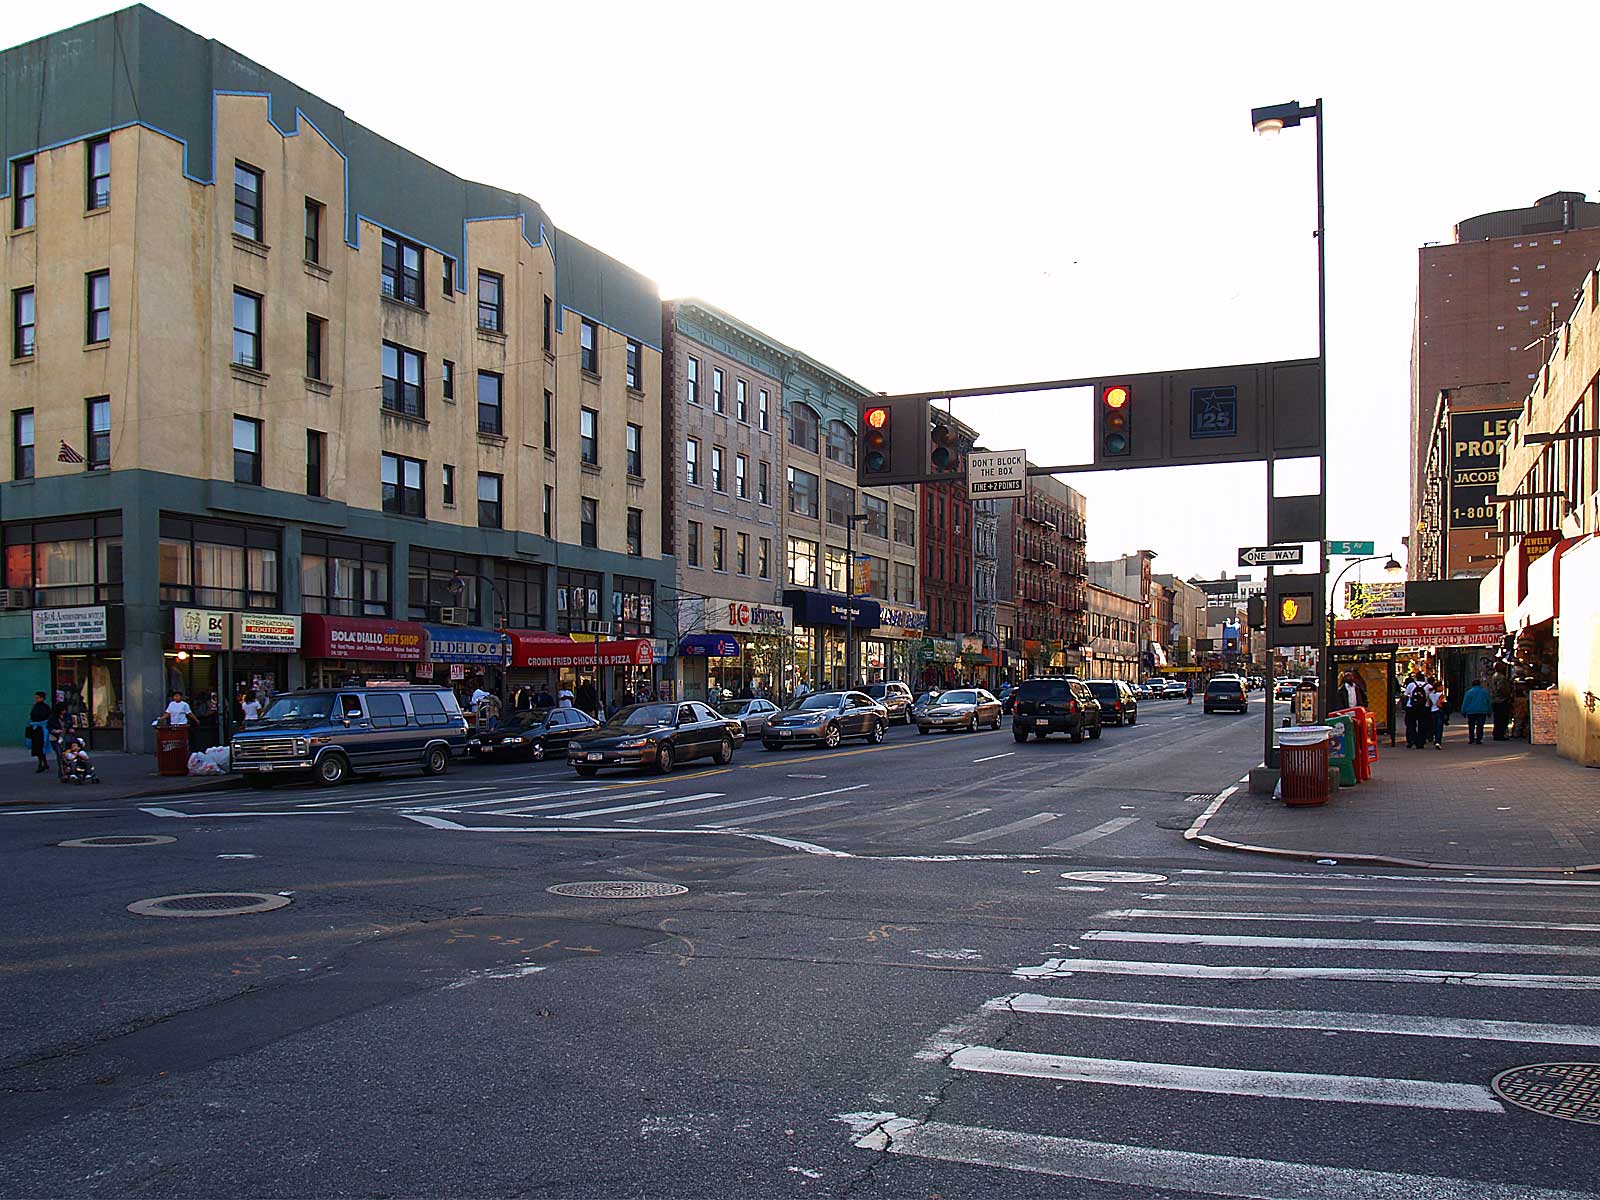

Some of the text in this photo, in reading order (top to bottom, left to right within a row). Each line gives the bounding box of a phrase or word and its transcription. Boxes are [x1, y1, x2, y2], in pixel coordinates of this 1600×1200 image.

[997, 456, 1021, 466] BLOCK
[981, 467, 1013, 477] THE BOX
[998, 480, 1020, 490] POINTS
[1524, 537, 1552, 546] JEWELRY
[1342, 542, 1351, 554] 5
[1247, 551, 1295, 561] ONE WAY
[245, 619, 294, 627] INTERNATIONAL
[251, 626, 289, 634] BOUTIQUE
[1352, 629, 1378, 637] WEST
[1382, 628, 1418, 636] DINNER
[1422, 626, 1466, 634] THEATRE
[357, 632, 382, 644] DIALLO
[383, 634, 399, 645] GIFT
[400, 634, 419, 645] SHOP
[1411, 636, 1435, 646] TRADE
[1437, 635, 1458, 645] GOLD
[447, 642, 474, 654] DELI
[528, 657, 552, 666] CROWN
[552, 657, 571, 666] FRIED
[572, 656, 602, 665] CHICKEN
[610, 655, 631, 664] PIZZA
[416, 663, 432, 673] ATM
[451, 665, 464, 674] ATM
